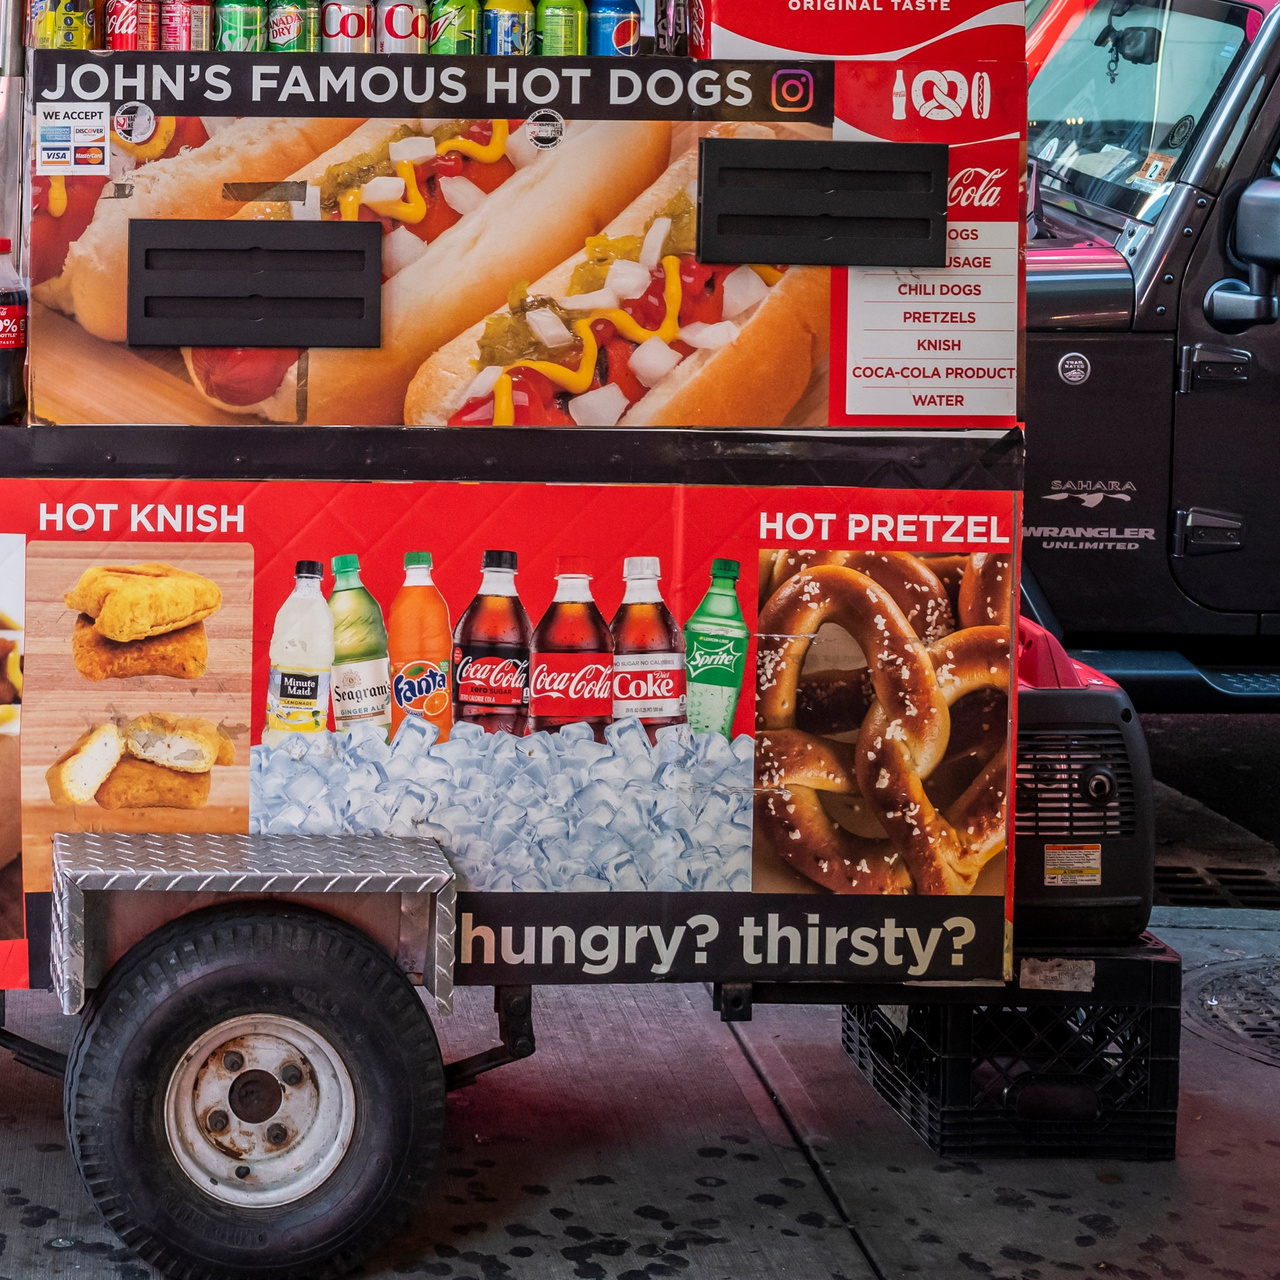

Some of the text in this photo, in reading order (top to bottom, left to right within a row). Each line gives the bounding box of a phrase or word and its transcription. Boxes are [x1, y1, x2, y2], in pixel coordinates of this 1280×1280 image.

[271, 26, 292, 40] DRY
[41, 63, 753, 107] JOHN'S FAMOUS HOT DOGS
[43, 111, 103, 120] WE ACCEPT
[46, 152, 67, 160] VISA
[948, 229, 979, 241] OGS
[945, 257, 992, 268] USAGE
[898, 284, 982, 296] CHILI DOGS
[903, 312, 976, 324] PRETZELS
[917, 339, 961, 351] KNISH
[852, 367, 1017, 379] COCA-COLA PRODUCT
[913, 395, 964, 407] WATER
[1051, 480, 1137, 491] SAHARA
[39, 503, 245, 532] HOT KNISH
[759, 512, 1010, 544] HOT PRETZEL
[1022, 526, 1156, 540] WRANGLER
[1042, 541, 1140, 550] UNLIMITED
[690, 651, 734, 666] Sprite
[456, 656, 530, 688] Coca-Cola
[653, 671, 670, 679] Diet
[284, 677, 316, 688] Minute
[530, 664, 614, 699] Coca-Cola
[614, 673, 674, 699] Coke
[287, 686, 312, 696] Maid
[335, 681, 391, 704] Seagram's
[393, 669, 447, 708] Fanta
[341, 704, 386, 716] GINGER ALE
[460, 912, 976, 976] hungry? thirsty?
